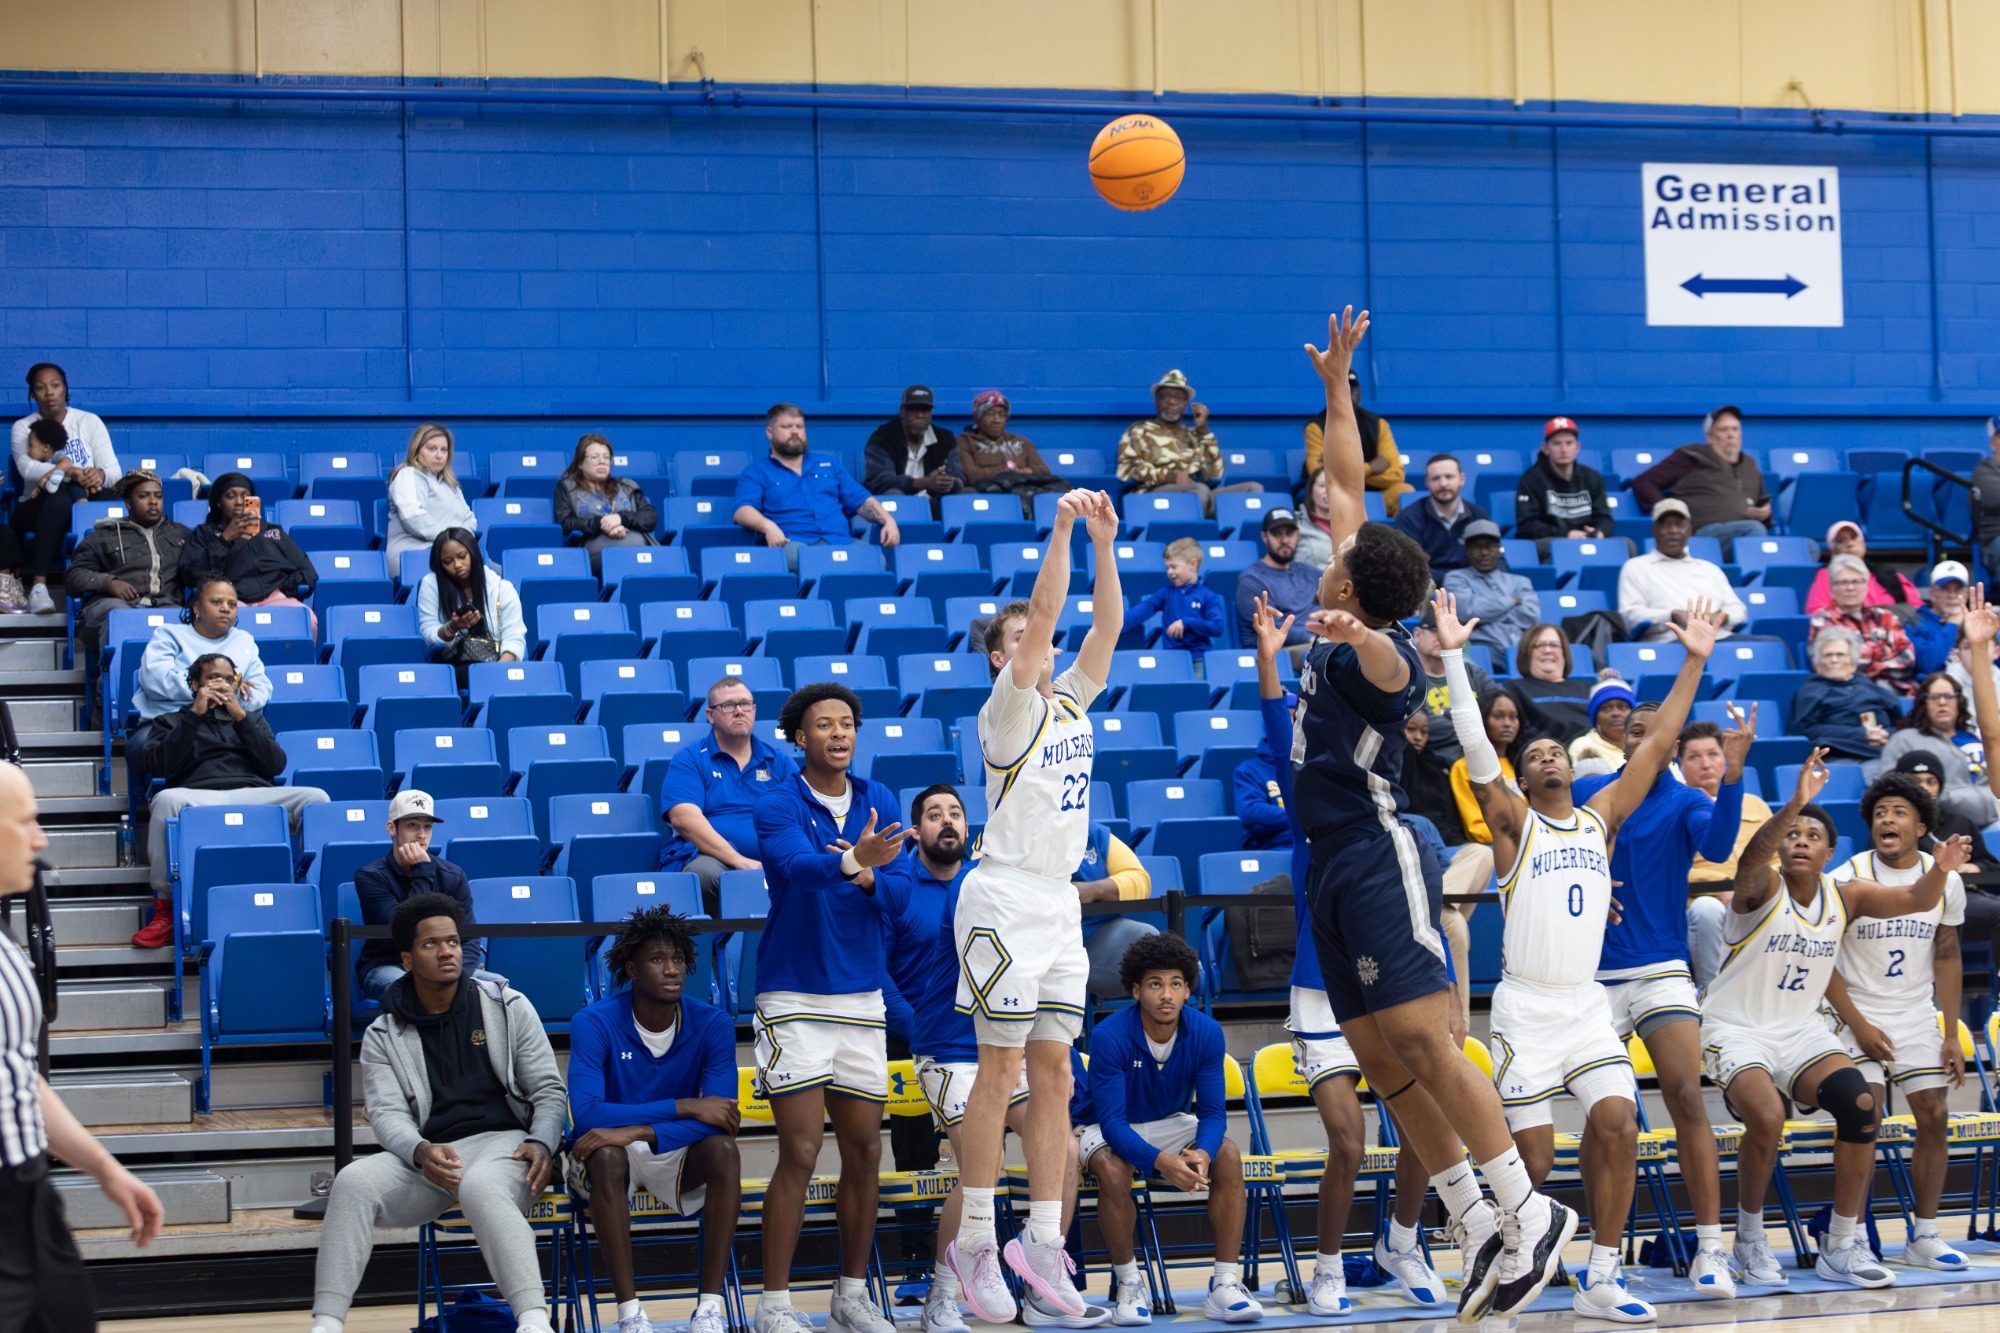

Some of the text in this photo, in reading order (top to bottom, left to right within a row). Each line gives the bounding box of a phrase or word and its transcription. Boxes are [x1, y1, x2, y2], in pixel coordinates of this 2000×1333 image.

[1110, 120, 1154, 137] NCAA
[1656, 174, 1826, 204] General
[1651, 206, 1835, 231] Admission
[1061, 772, 1089, 811] 22
[1568, 883, 1584, 917] 0
[1885, 949, 1905, 977] 2
[1777, 964, 1810, 991] 12
